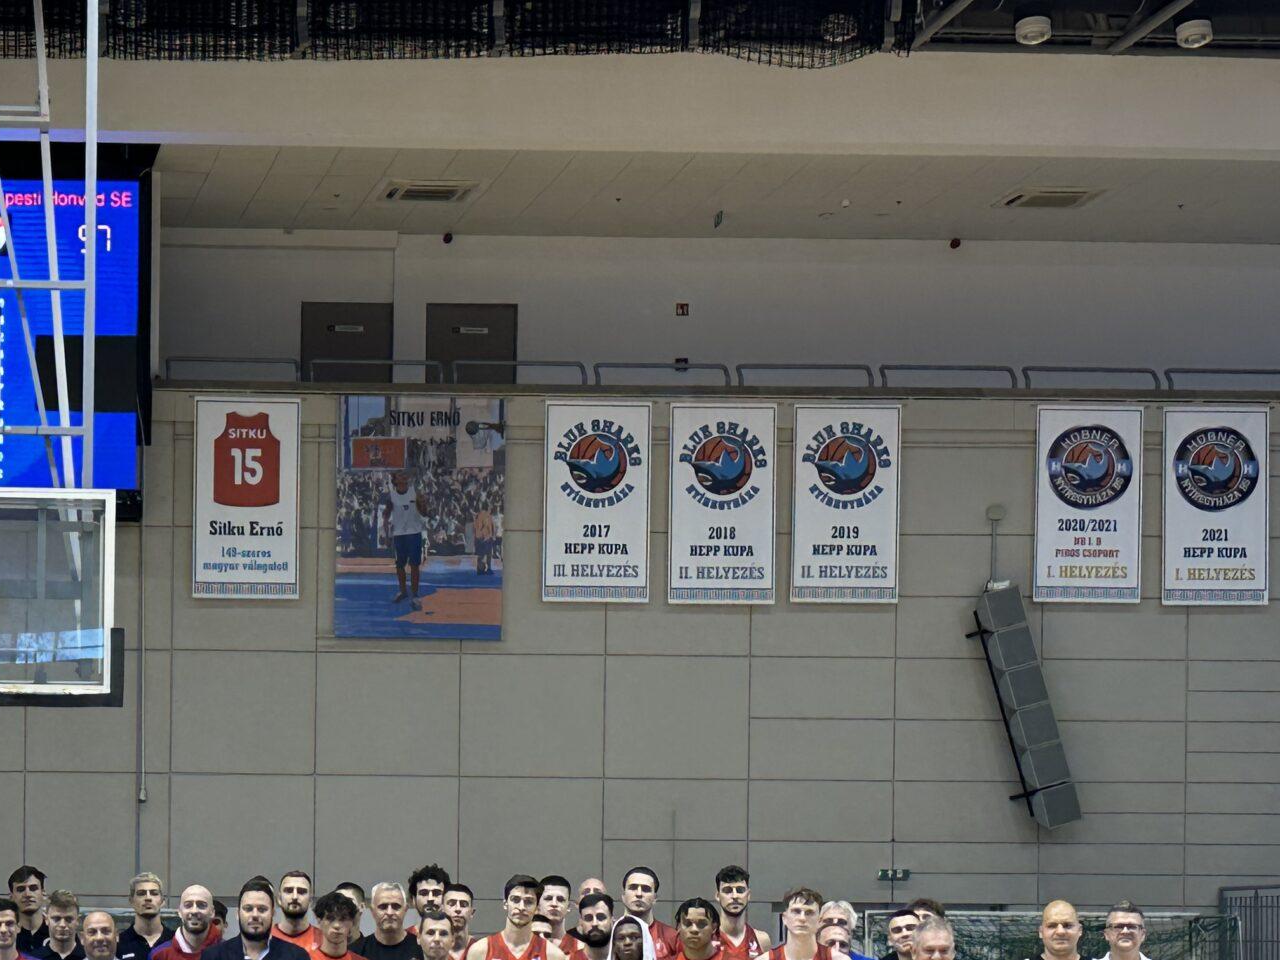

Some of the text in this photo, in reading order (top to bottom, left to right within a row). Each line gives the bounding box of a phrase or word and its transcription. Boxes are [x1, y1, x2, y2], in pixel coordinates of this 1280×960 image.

[110, 192, 132, 207] SE
[390, 408, 460, 426] SITKU ERNŐ
[228, 428, 267, 439] SITKU
[554, 419, 642, 466] BLUE SHARKS
[679, 421, 767, 469] BLUE SHARKS
[802, 421, 891, 468] BLUE SHARKS
[231, 448, 263, 485] 15
[1244, 464, 1252, 474] H
[209, 520, 283, 537] Sitku Ernő
[583, 524, 611, 538] 2017
[831, 526, 859, 539] 2019
[1058, 519, 1117, 532] 2020/2021
[708, 527, 736, 540] 2018
[1202, 529, 1228, 541] 2021
[565, 543, 629, 555] HEPP KUPA
[690, 545, 753, 556] HEPP KUPA
[812, 545, 877, 556] HEPP KUPA
[1184, 547, 1247, 558] HEPP KUPA
[203, 562, 239, 572] magyar
[553, 561, 638, 577] III. HELYEZÉS
[679, 563, 764, 580] II. HELYEZÉS
[819, 562, 887, 578] HELYEZÉS
[1047, 562, 1127, 578] I. HELYEZÉS
[1187, 564, 1256, 580] HELYEZÉS
